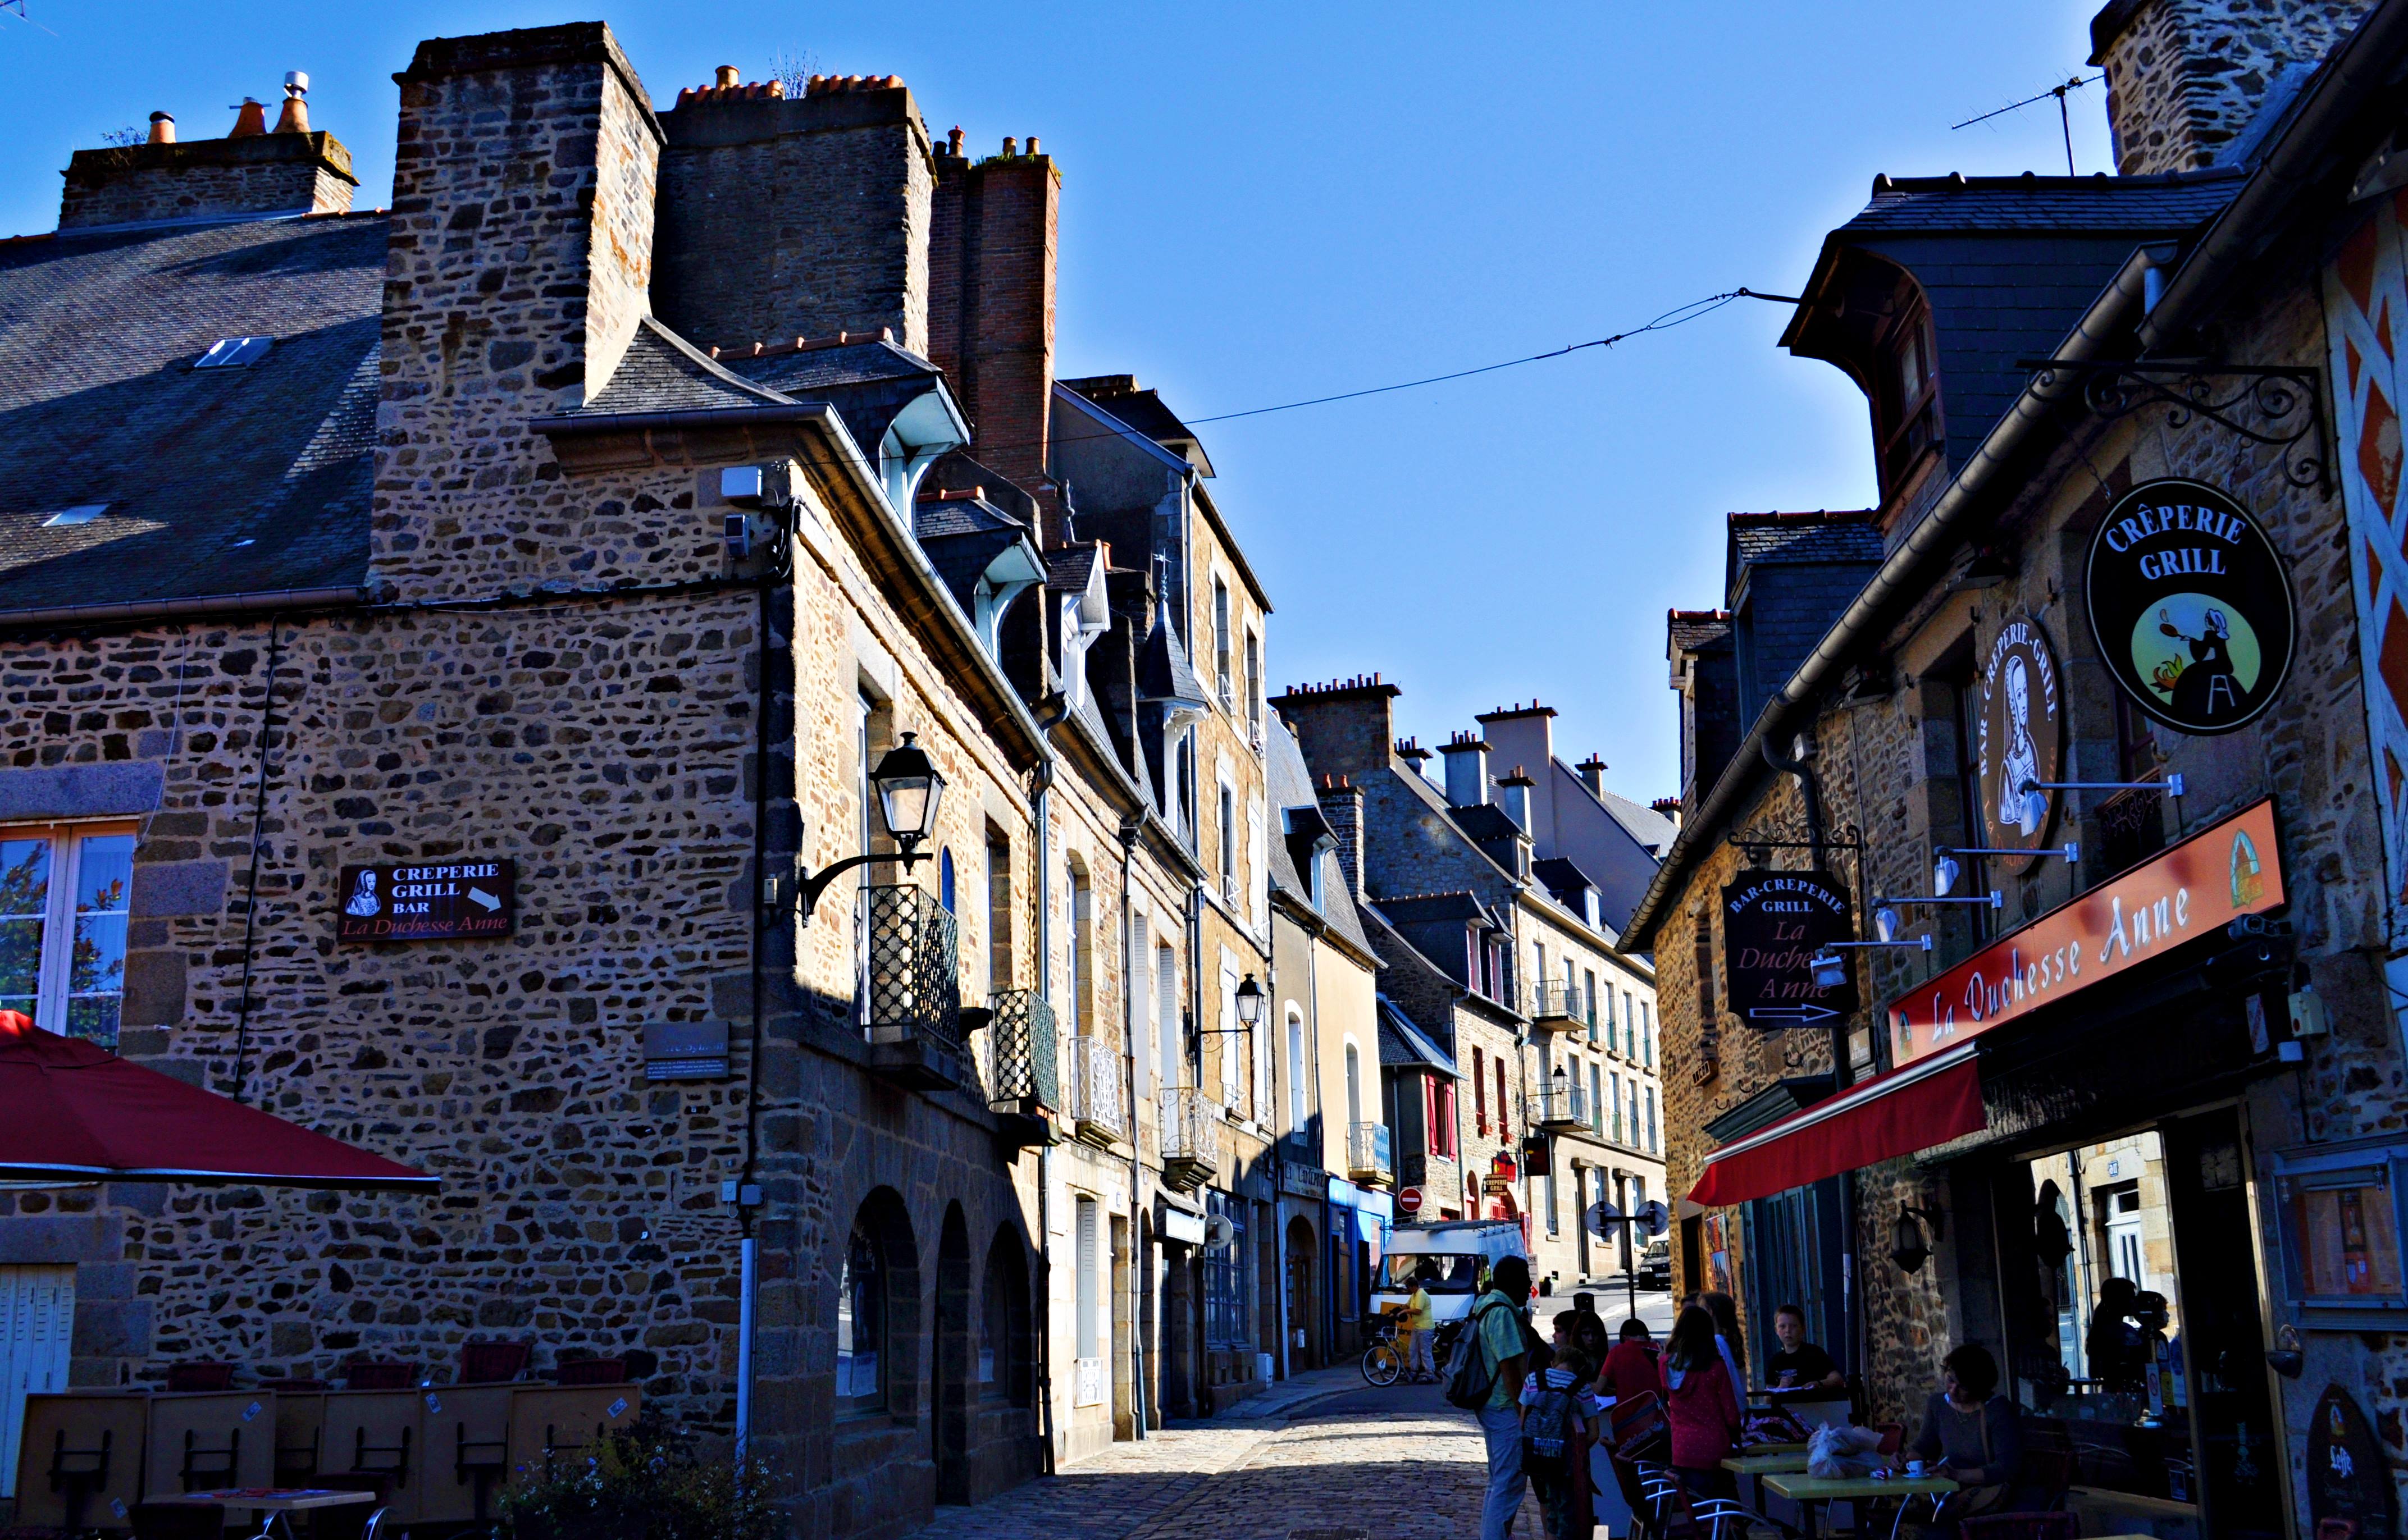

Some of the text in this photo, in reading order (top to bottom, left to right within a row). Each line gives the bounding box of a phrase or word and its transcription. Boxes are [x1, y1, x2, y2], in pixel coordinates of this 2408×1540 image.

[2106, 504, 2246, 552] CRÊPERIE
[2140, 548, 2225, 580] GRILL
[1985, 622, 2029, 701] CREPERIE
[2033, 638, 2056, 722] GRILL
[393, 863, 499, 881] CREPERIE
[392, 883, 460, 898] GRILL
[393, 902, 430, 913] BAR
[1762, 901, 1813, 912] GRILL
[342, 914, 508, 935] La Duchesse Anne
[1772, 921, 1805, 940] La
[1737, 945, 1847, 973] Duche
[1932, 888, 2188, 1041] La Duchesse Anne
[1759, 979, 1831, 998] Anne
